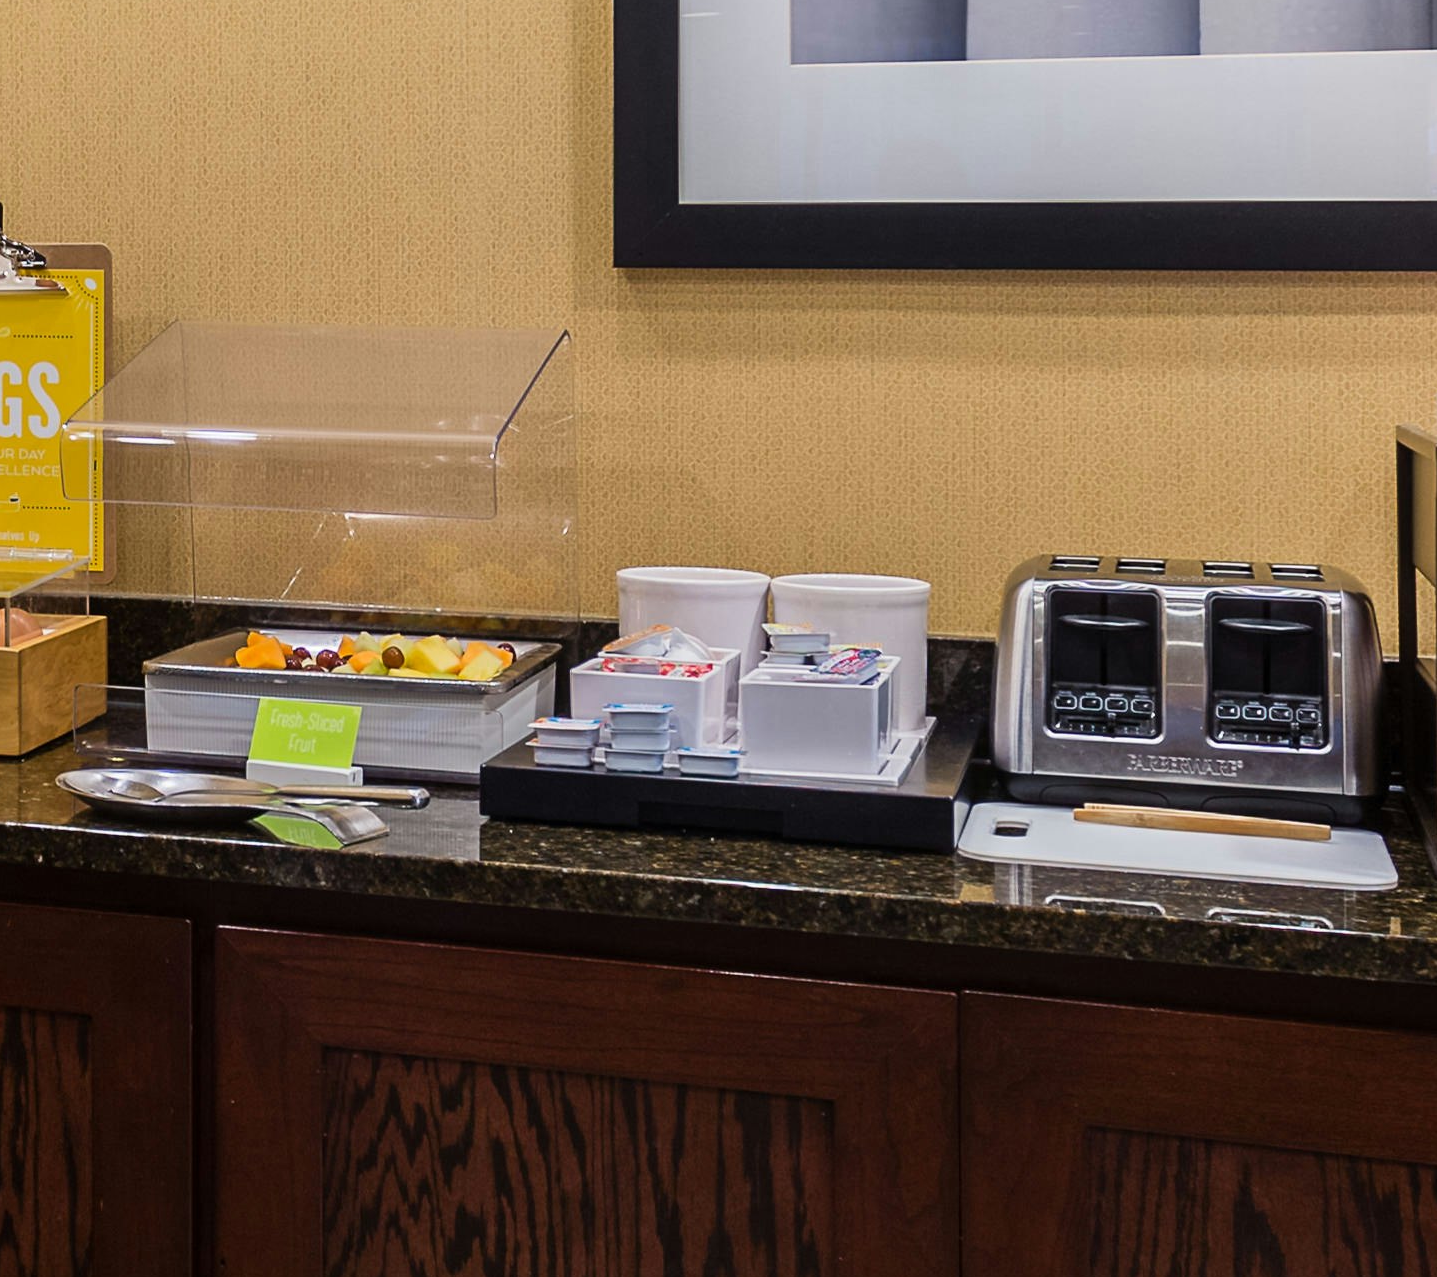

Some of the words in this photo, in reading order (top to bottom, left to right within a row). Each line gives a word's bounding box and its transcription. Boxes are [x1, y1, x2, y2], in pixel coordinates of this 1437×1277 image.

[18, 449, 46, 460] DAY
[28, 530, 40, 543] Up
[270, 707, 345, 733] Fresh-Sliced
[288, 732, 317, 754] Fruit
